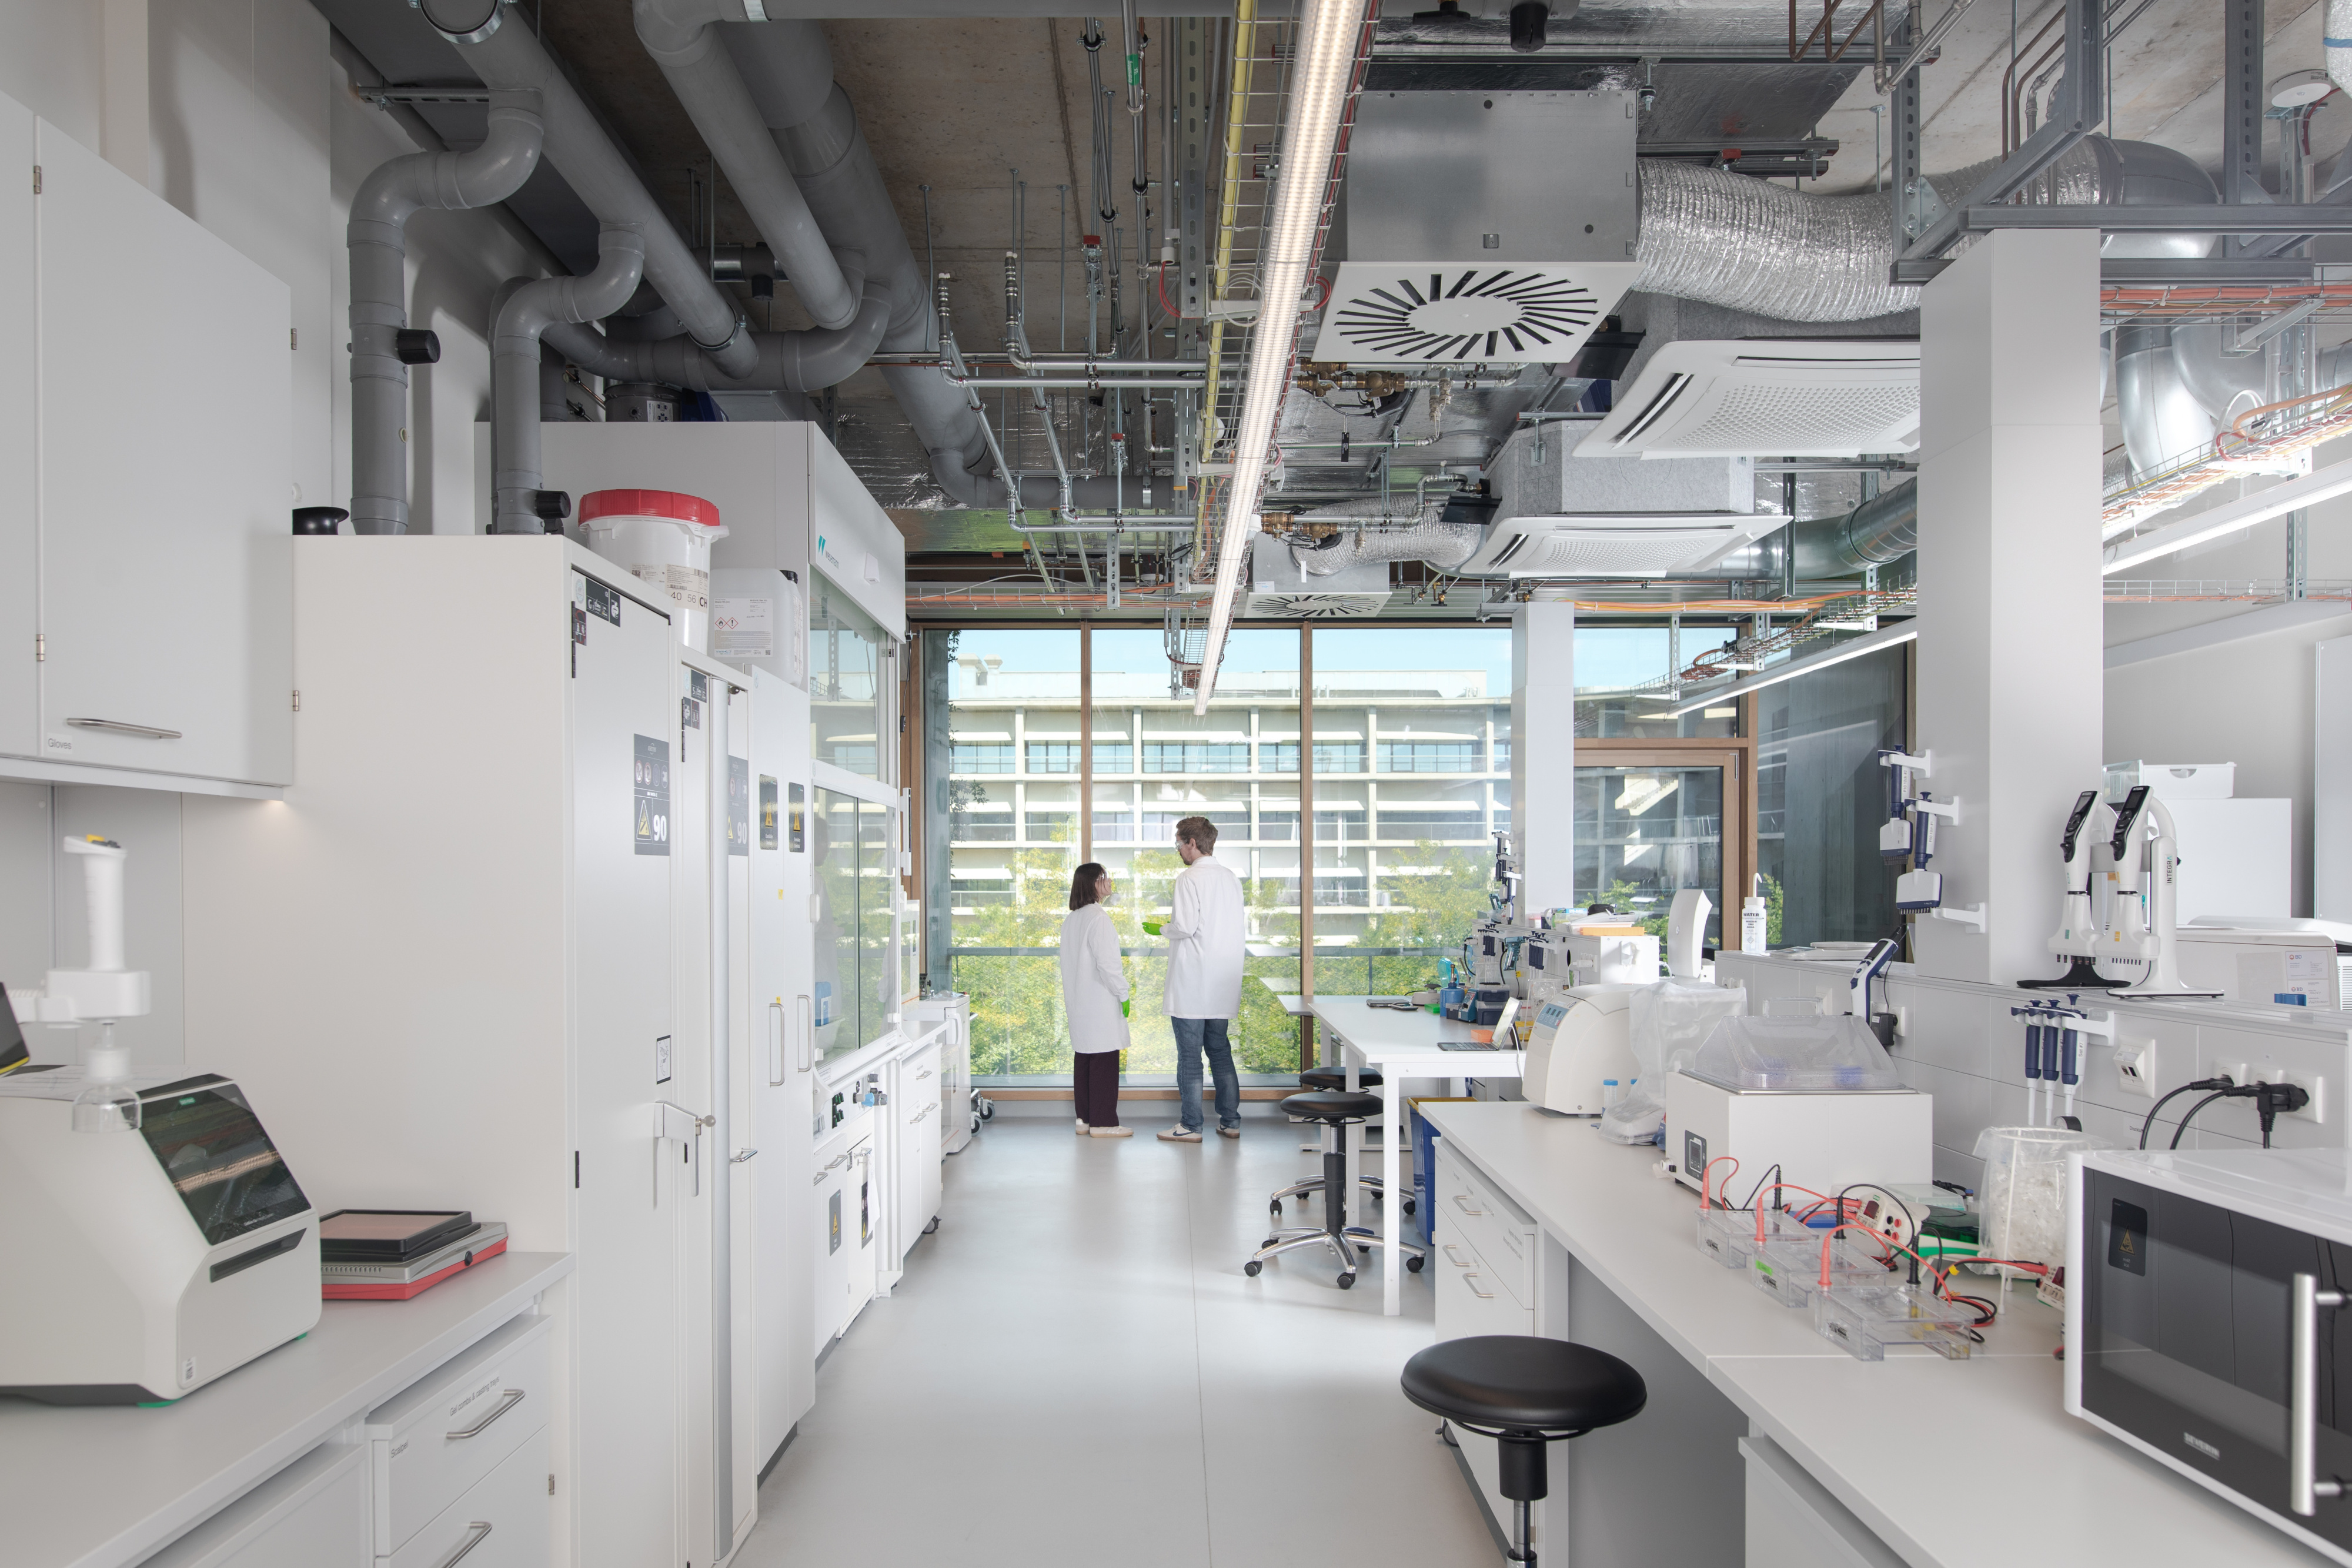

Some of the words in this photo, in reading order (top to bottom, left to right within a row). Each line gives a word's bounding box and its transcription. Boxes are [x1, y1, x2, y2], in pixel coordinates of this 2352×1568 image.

[826, 550, 839, 569] wesemann
[671, 591, 682, 600] 40
[687, 594, 696, 603] 56
[699, 597, 708, 608] CH
[48, 738, 72, 750] Gloves
[653, 814, 667, 841] 90
[737, 821, 747, 844] 90
[391, 1440, 408, 1458] Scalpel
